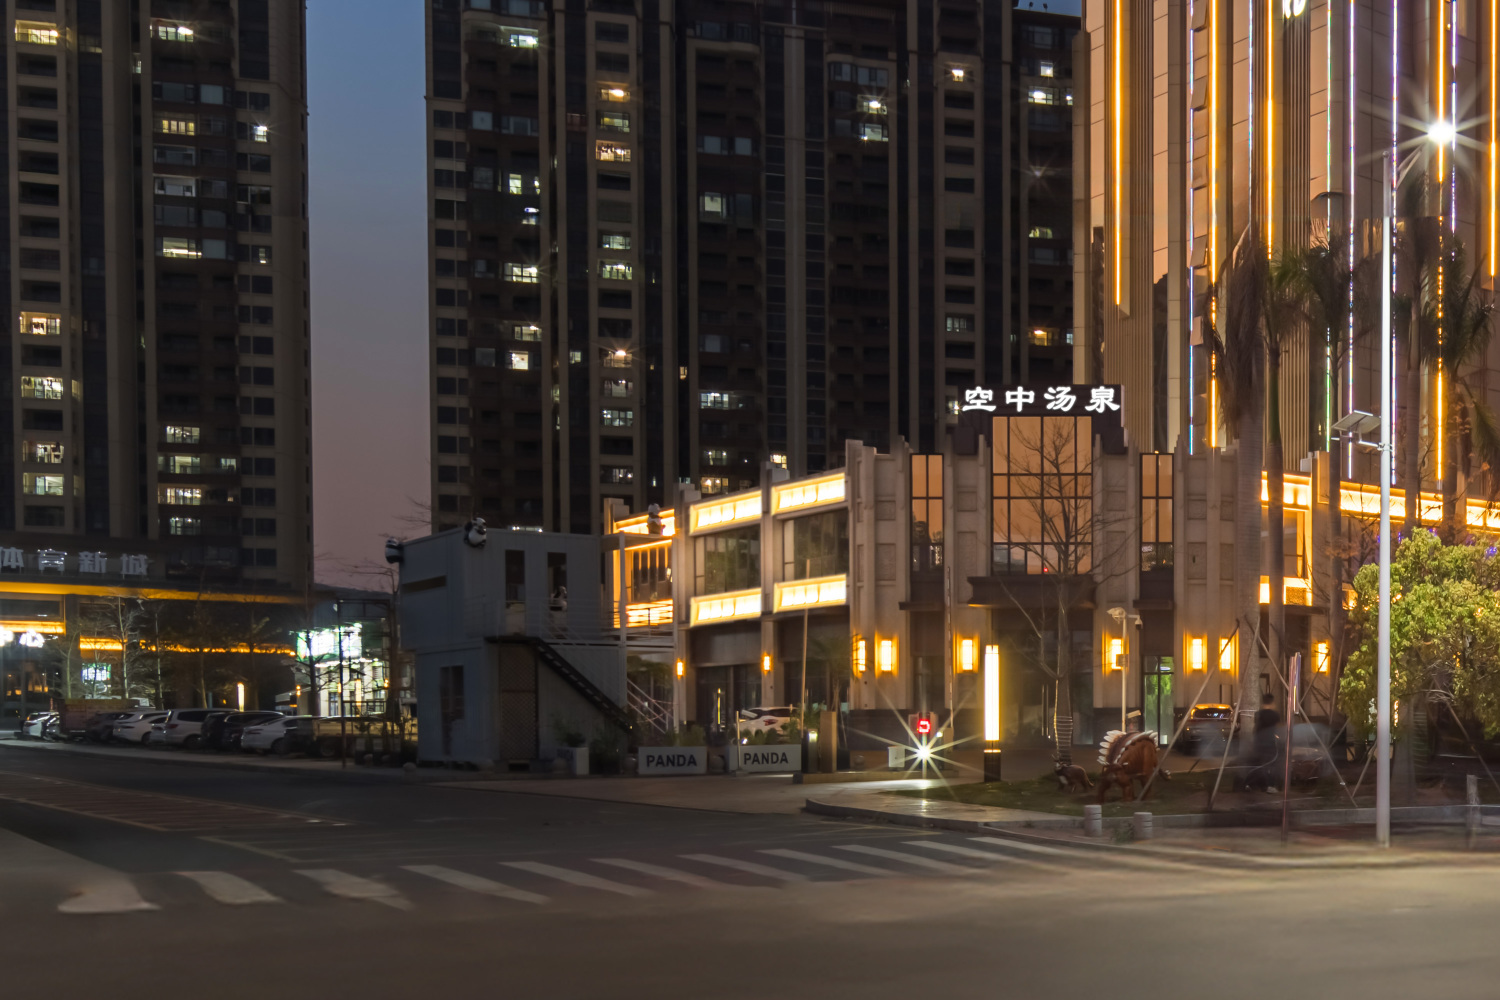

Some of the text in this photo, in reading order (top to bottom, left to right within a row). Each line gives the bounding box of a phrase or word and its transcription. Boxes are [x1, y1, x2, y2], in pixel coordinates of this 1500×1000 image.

[961, 385, 1121, 414] 空中汤泉
[646, 754, 698, 768] PANDA
[744, 751, 789, 766] PANDA
